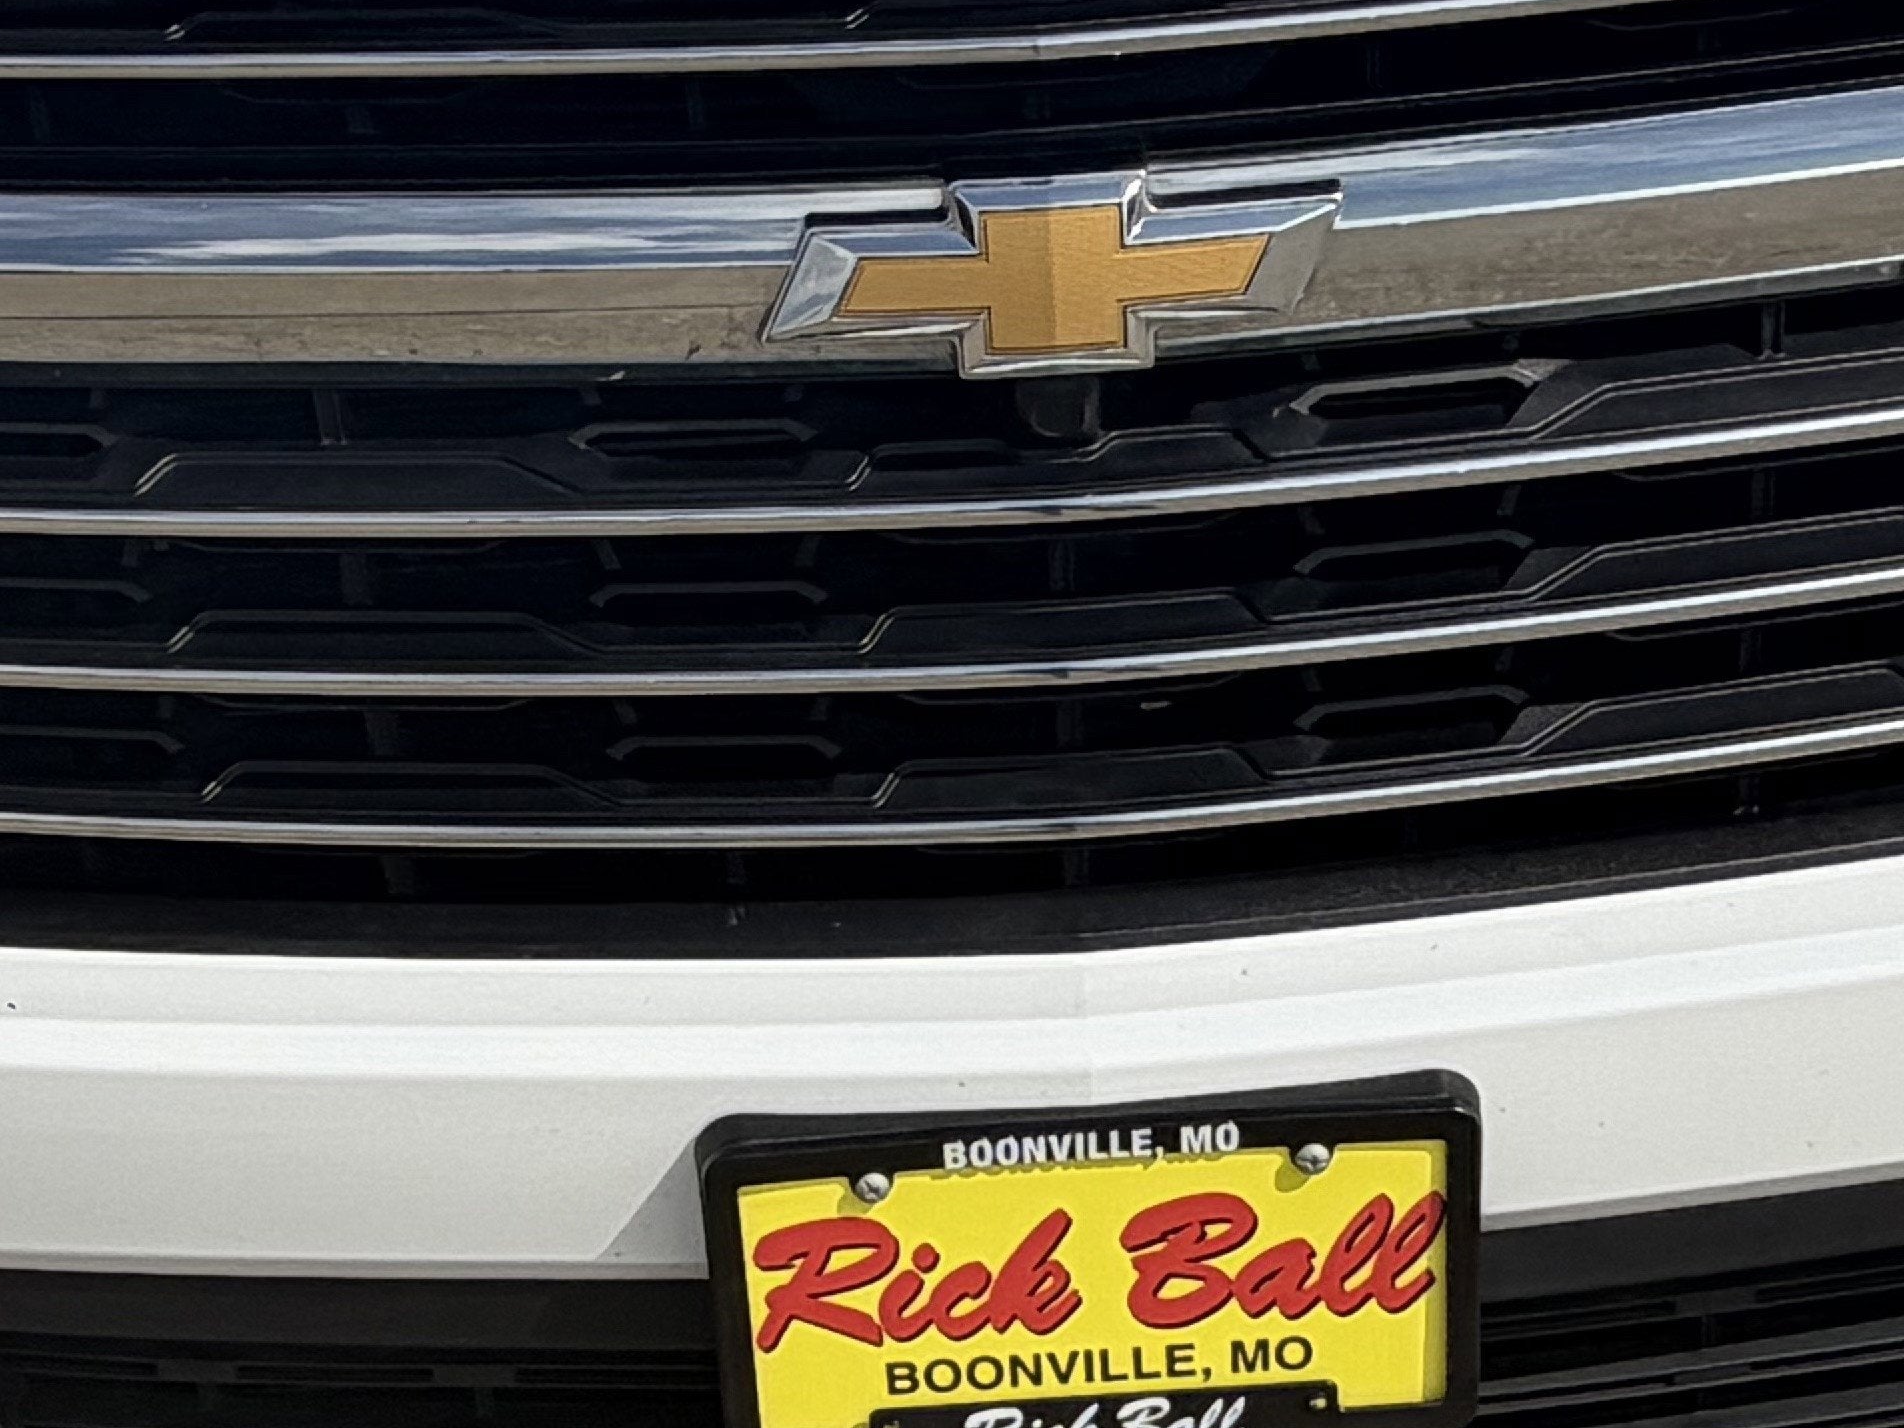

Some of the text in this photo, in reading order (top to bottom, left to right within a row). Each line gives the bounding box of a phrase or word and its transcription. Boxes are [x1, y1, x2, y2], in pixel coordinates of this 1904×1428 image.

[942, 1120, 1241, 1171] BOONVILLE, MO
[752, 1191, 1448, 1354] Rick Ball
[884, 1335, 1314, 1397] BOONVILLE, MO
